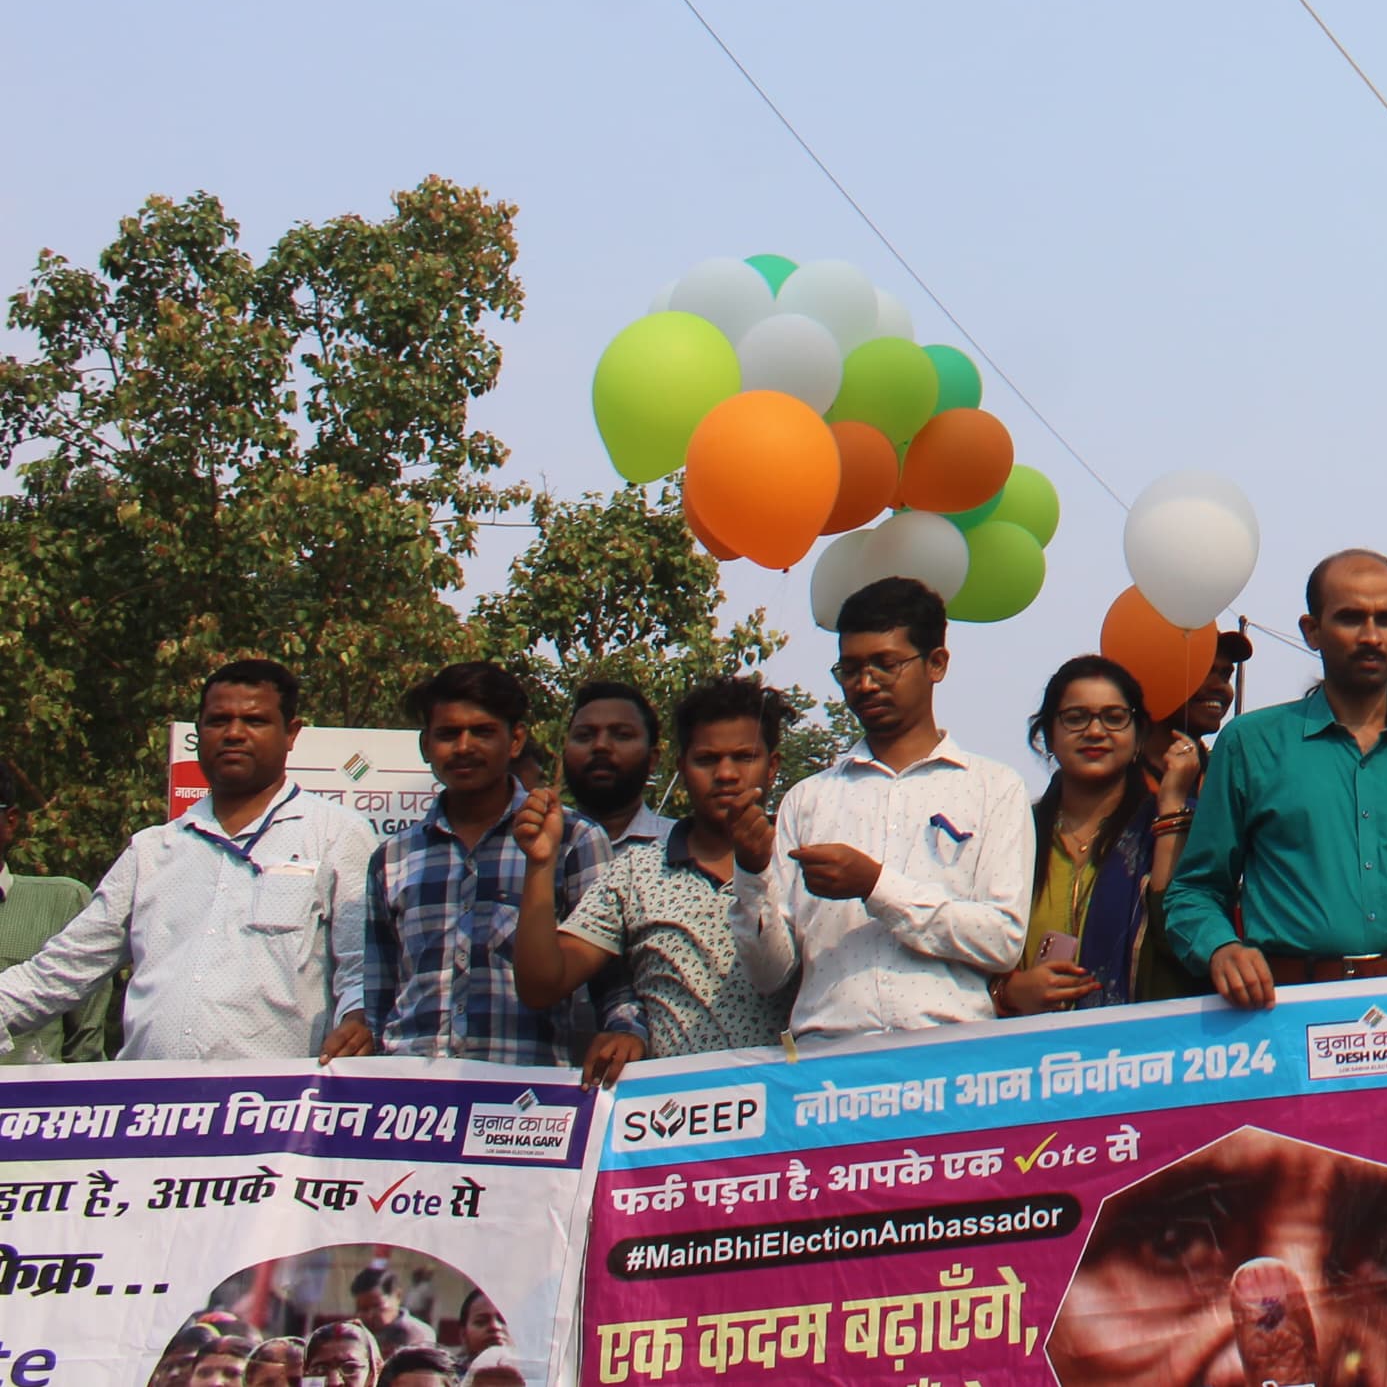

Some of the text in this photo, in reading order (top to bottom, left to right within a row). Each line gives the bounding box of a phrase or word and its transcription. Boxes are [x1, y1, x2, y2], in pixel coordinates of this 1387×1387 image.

[353, 791, 392, 813] का
[1313, 1033, 1367, 1058] चुनाव
[1335, 1051, 1370, 1064] DESH
[794, 1039, 1275, 1127] लोकसभा आम निर्वाचन 2024
[125, 1101, 219, 1138] आम
[223, 1089, 374, 1137] निर्वाचन
[373, 1104, 458, 1143] 2024
[473, 1112, 573, 1137] चुनाव का पर्व
[623, 1099, 758, 1143] SWEEP
[485, 1134, 563, 1147] DESH KA GARV
[86, 1169, 128, 1218] है,
[148, 1165, 282, 1211] आपके
[295, 1176, 364, 1212] एक
[450, 1176, 485, 1217] से
[612, 1174, 687, 1216] फर्क
[694, 1170, 779, 1214] पड़ता
[784, 1160, 820, 1202] है,
[828, 1149, 936, 1192] आपके
[941, 1147, 1004, 1181] एक
[1106, 1124, 1142, 1163] से
[626, 1203, 1064, 1271] #MainBhiElectionAmbassador
[597, 1317, 688, 1384] एक
[697, 1302, 831, 1374] कदम
